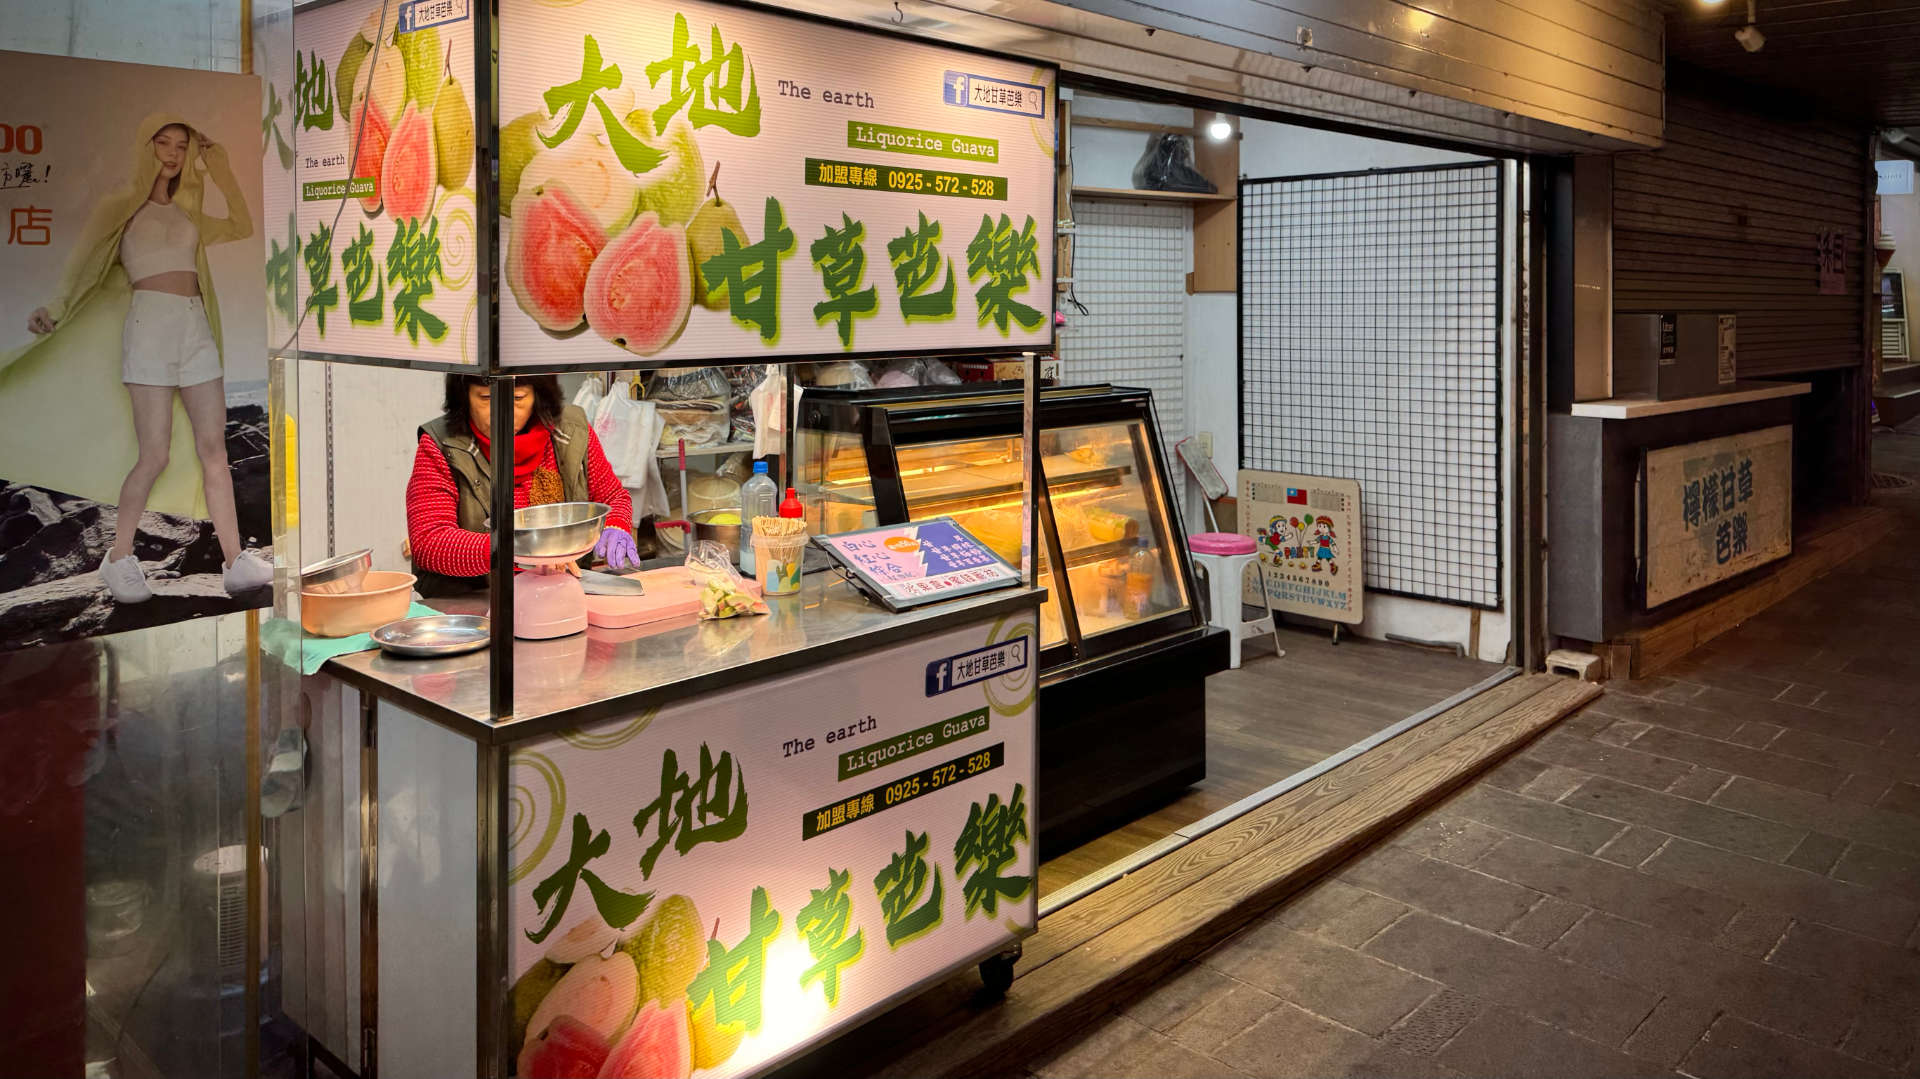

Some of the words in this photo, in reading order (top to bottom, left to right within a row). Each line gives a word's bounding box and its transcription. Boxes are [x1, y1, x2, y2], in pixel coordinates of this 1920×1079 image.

[536, 12, 762, 177] 大地
[778, 79, 811, 100] The
[823, 91, 875, 109] earth
[974, 84, 1023, 108] 大地甘草芭樂
[305, 157, 319, 168] The
[322, 154, 345, 167] earth
[856, 126, 943, 151] Liquorice
[952, 138, 995, 157] Guava
[306, 183, 346, 199] Liquorice
[350, 182, 374, 193] Guava
[818, 163, 878, 187] 加盟專線
[8, 205, 53, 245] 店
[701, 197, 1046, 347] 甘草芭樂
[1716, 512, 1748, 565] 芭樂
[957, 650, 1006, 680] 大地甘草芭樂
[782, 740, 815, 758] The
[826, 715, 877, 743] earth
[847, 735, 934, 772] Liquorice
[942, 714, 986, 738] Guava
[816, 793, 875, 832] 加盟專線
[524, 742, 749, 945] 大地
[687, 783, 1032, 1032] 甘草芭樂
